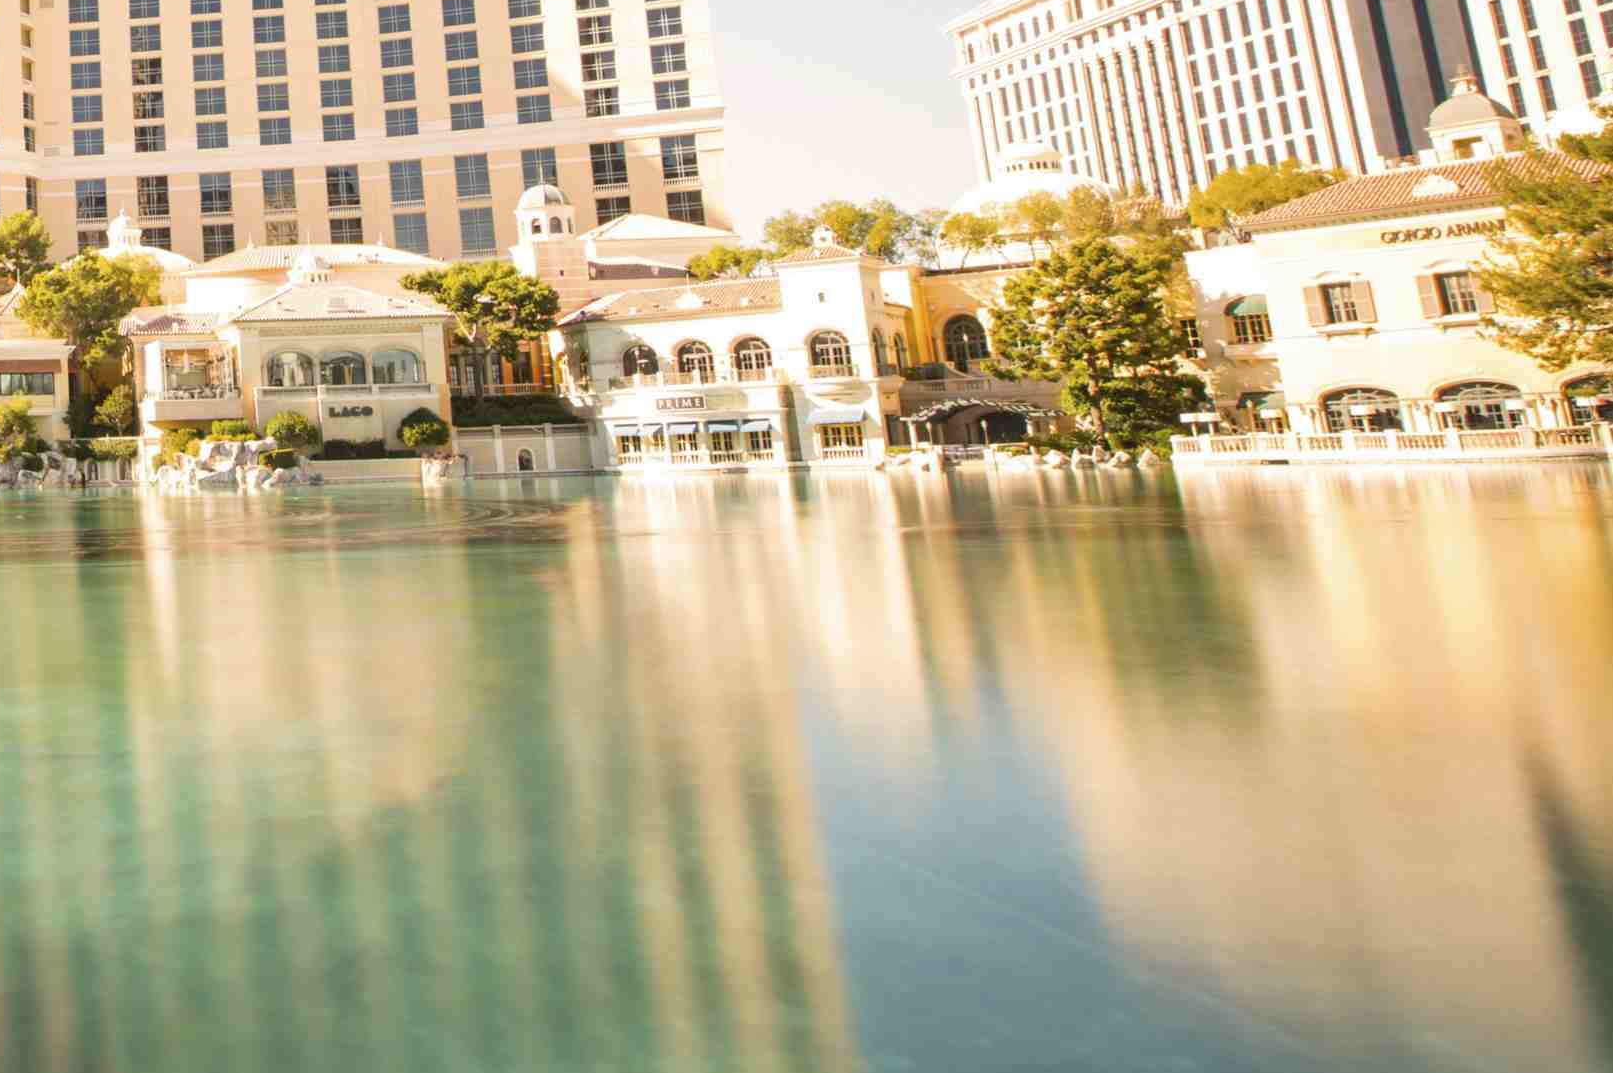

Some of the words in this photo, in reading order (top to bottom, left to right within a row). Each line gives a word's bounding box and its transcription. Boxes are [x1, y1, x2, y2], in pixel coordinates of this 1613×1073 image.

[1381, 226, 1442, 244] GIORGIO
[658, 398, 702, 409] PRIME
[329, 406, 373, 418] LAGO
